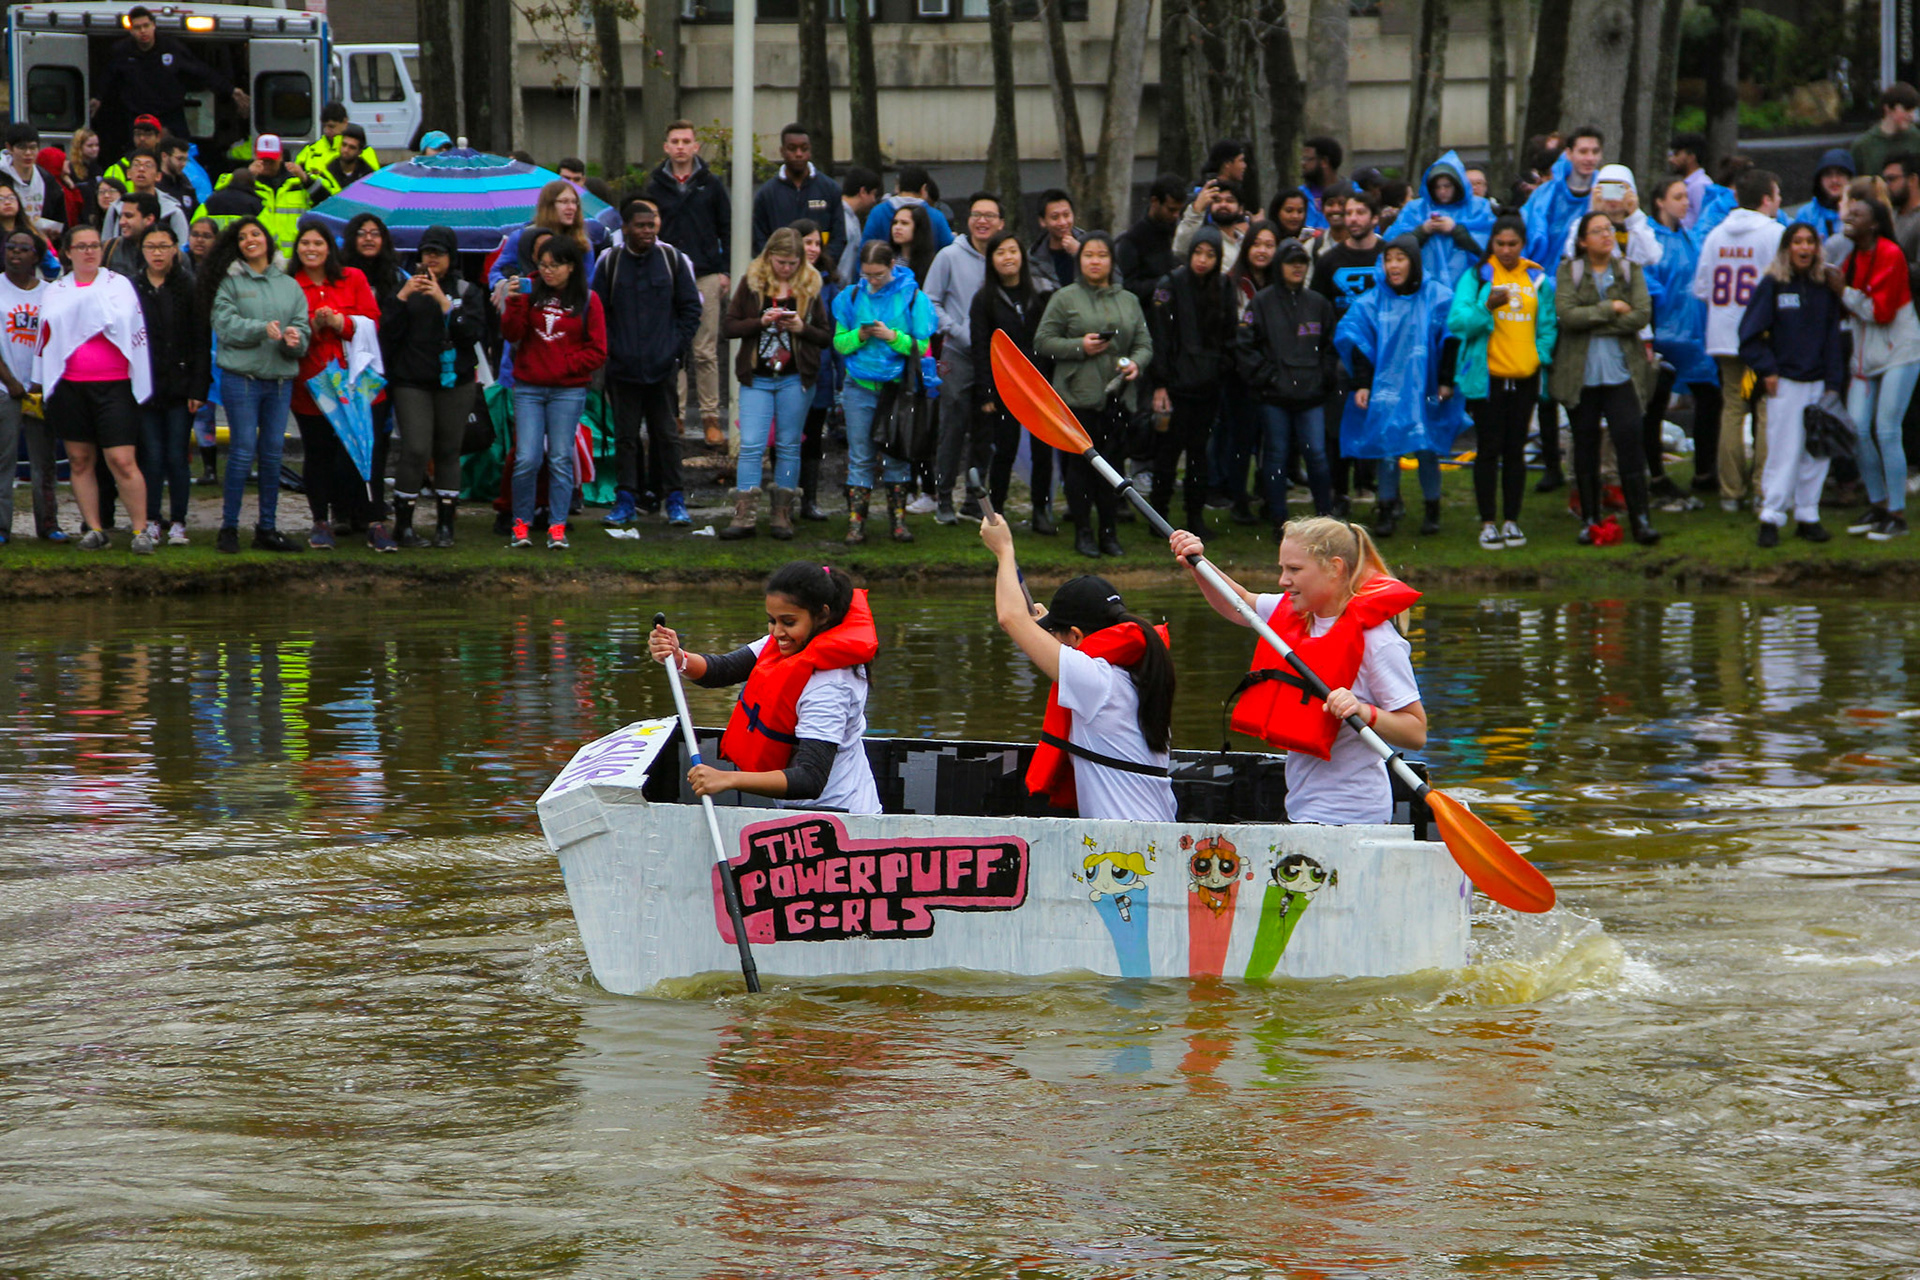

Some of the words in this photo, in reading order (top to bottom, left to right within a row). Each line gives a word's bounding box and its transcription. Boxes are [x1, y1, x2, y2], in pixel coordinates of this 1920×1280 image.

[1712, 264, 1758, 307] 86
[1497, 310, 1532, 322] ROMA
[754, 825, 824, 864] THE
[739, 848, 1004, 907] POWERPUFF
